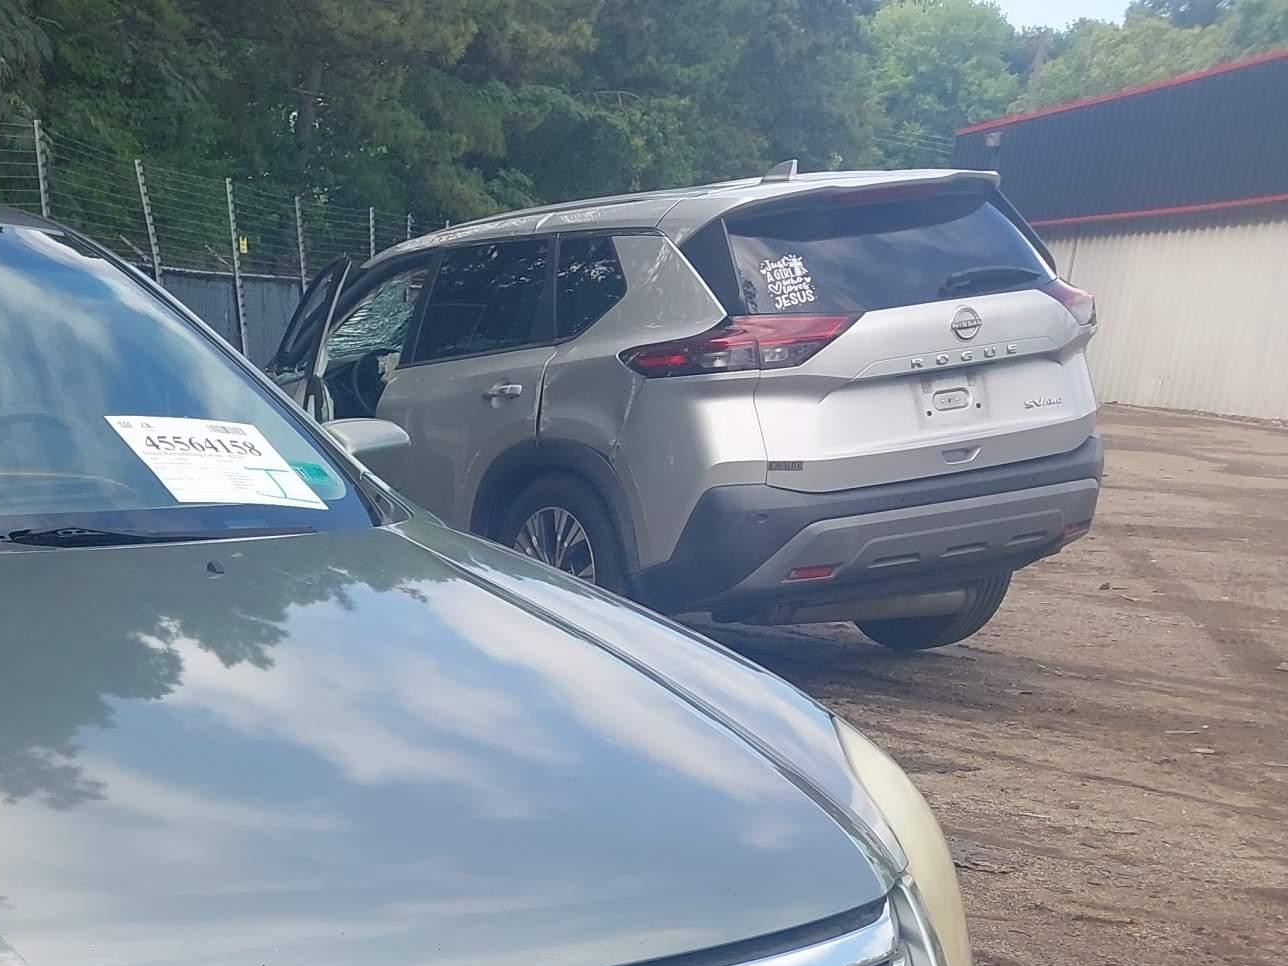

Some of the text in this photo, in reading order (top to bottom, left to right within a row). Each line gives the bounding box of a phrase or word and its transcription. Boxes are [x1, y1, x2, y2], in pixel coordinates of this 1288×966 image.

[766, 267, 795, 283] A GIRL
[782, 276, 804, 286] who
[782, 282, 810, 294] loves
[775, 290, 815, 308] JESUS
[951, 318, 983, 330] NISSAN
[911, 344, 1017, 369] ROGUE
[144, 435, 262, 457] 45564158
